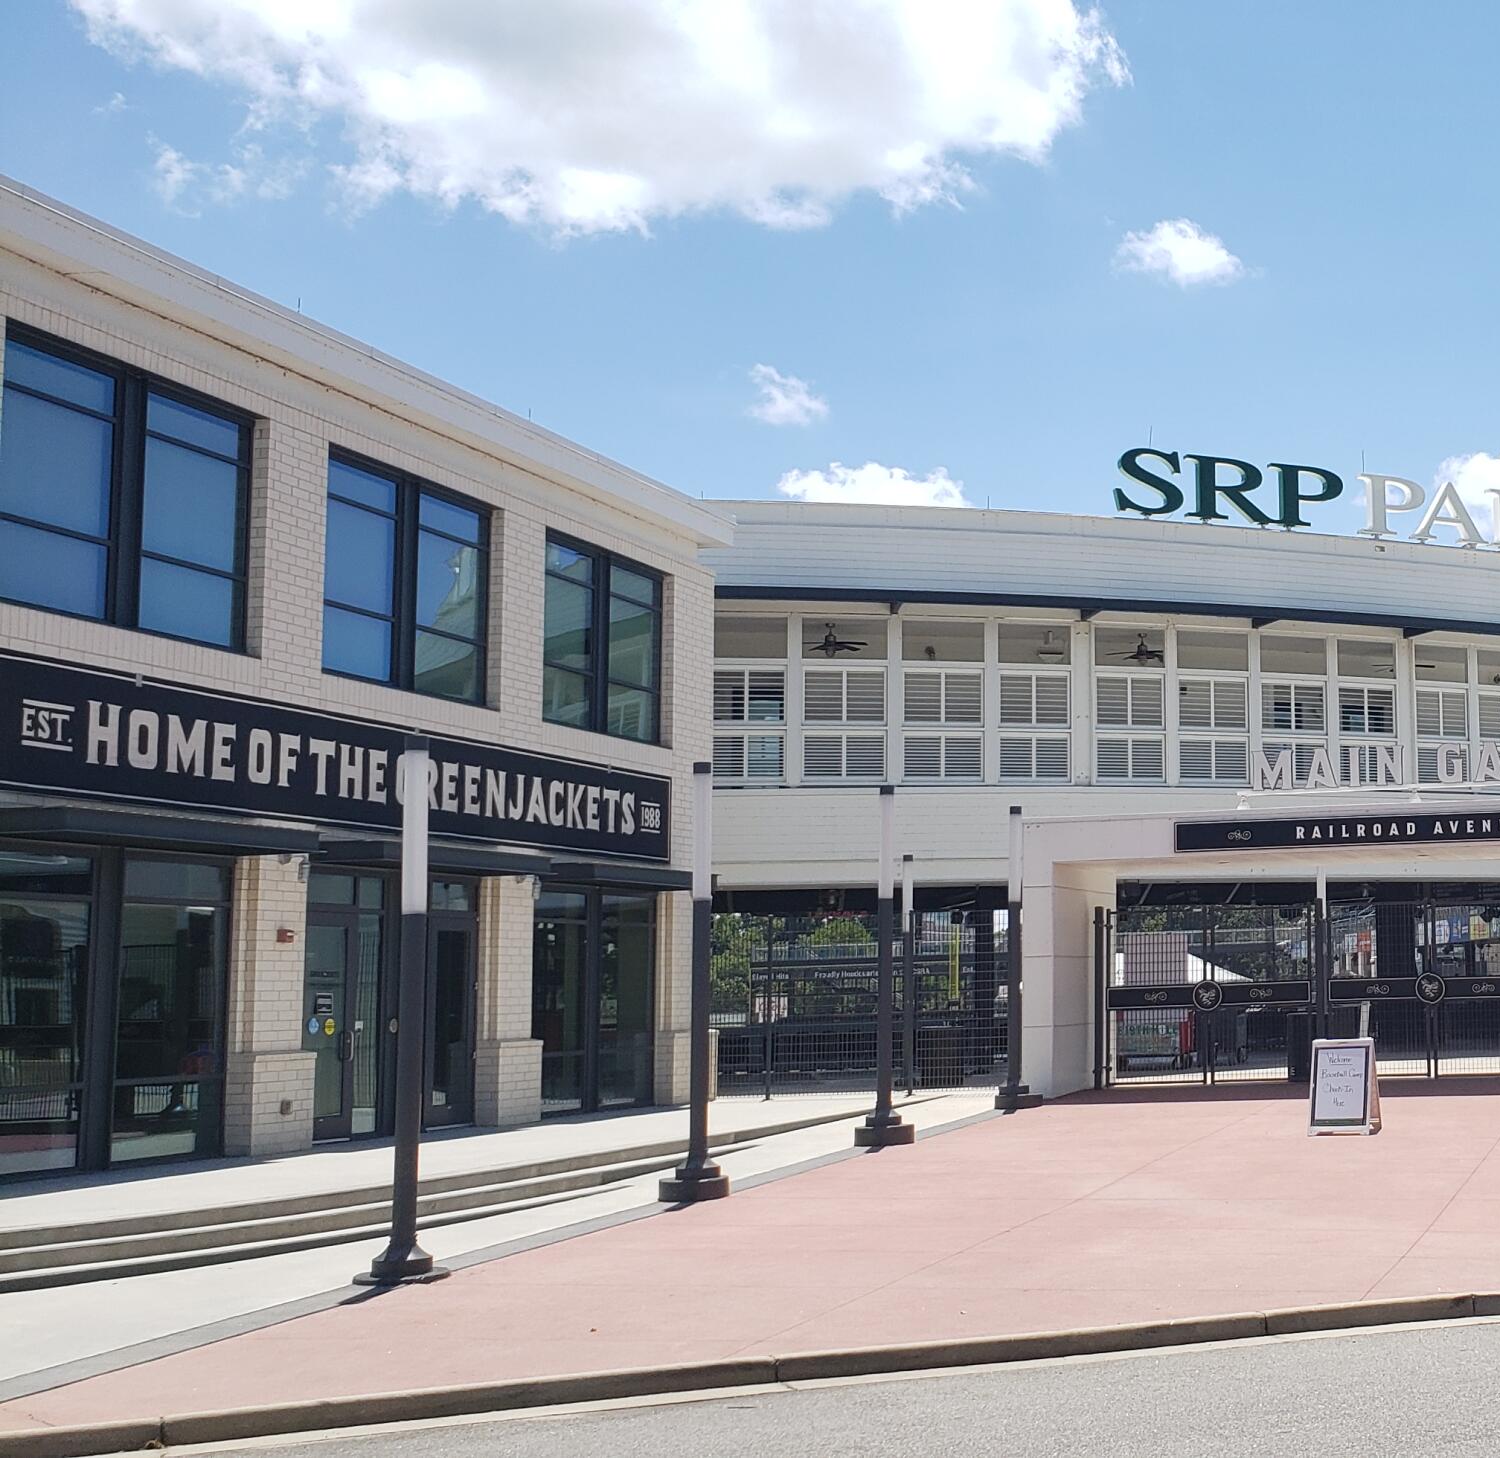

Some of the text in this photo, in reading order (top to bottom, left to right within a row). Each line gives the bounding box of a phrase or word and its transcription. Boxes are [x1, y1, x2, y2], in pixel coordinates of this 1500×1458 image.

[1112, 447, 1344, 527] SRP
[21, 707, 72, 743] EST.
[86, 700, 237, 782] HOME
[248, 728, 300, 787] OF
[309, 737, 388, 805] THE
[1252, 744, 1405, 791] MAIN
[640, 805, 661, 830] 1988
[1296, 821, 1417, 840] RAILROAD
